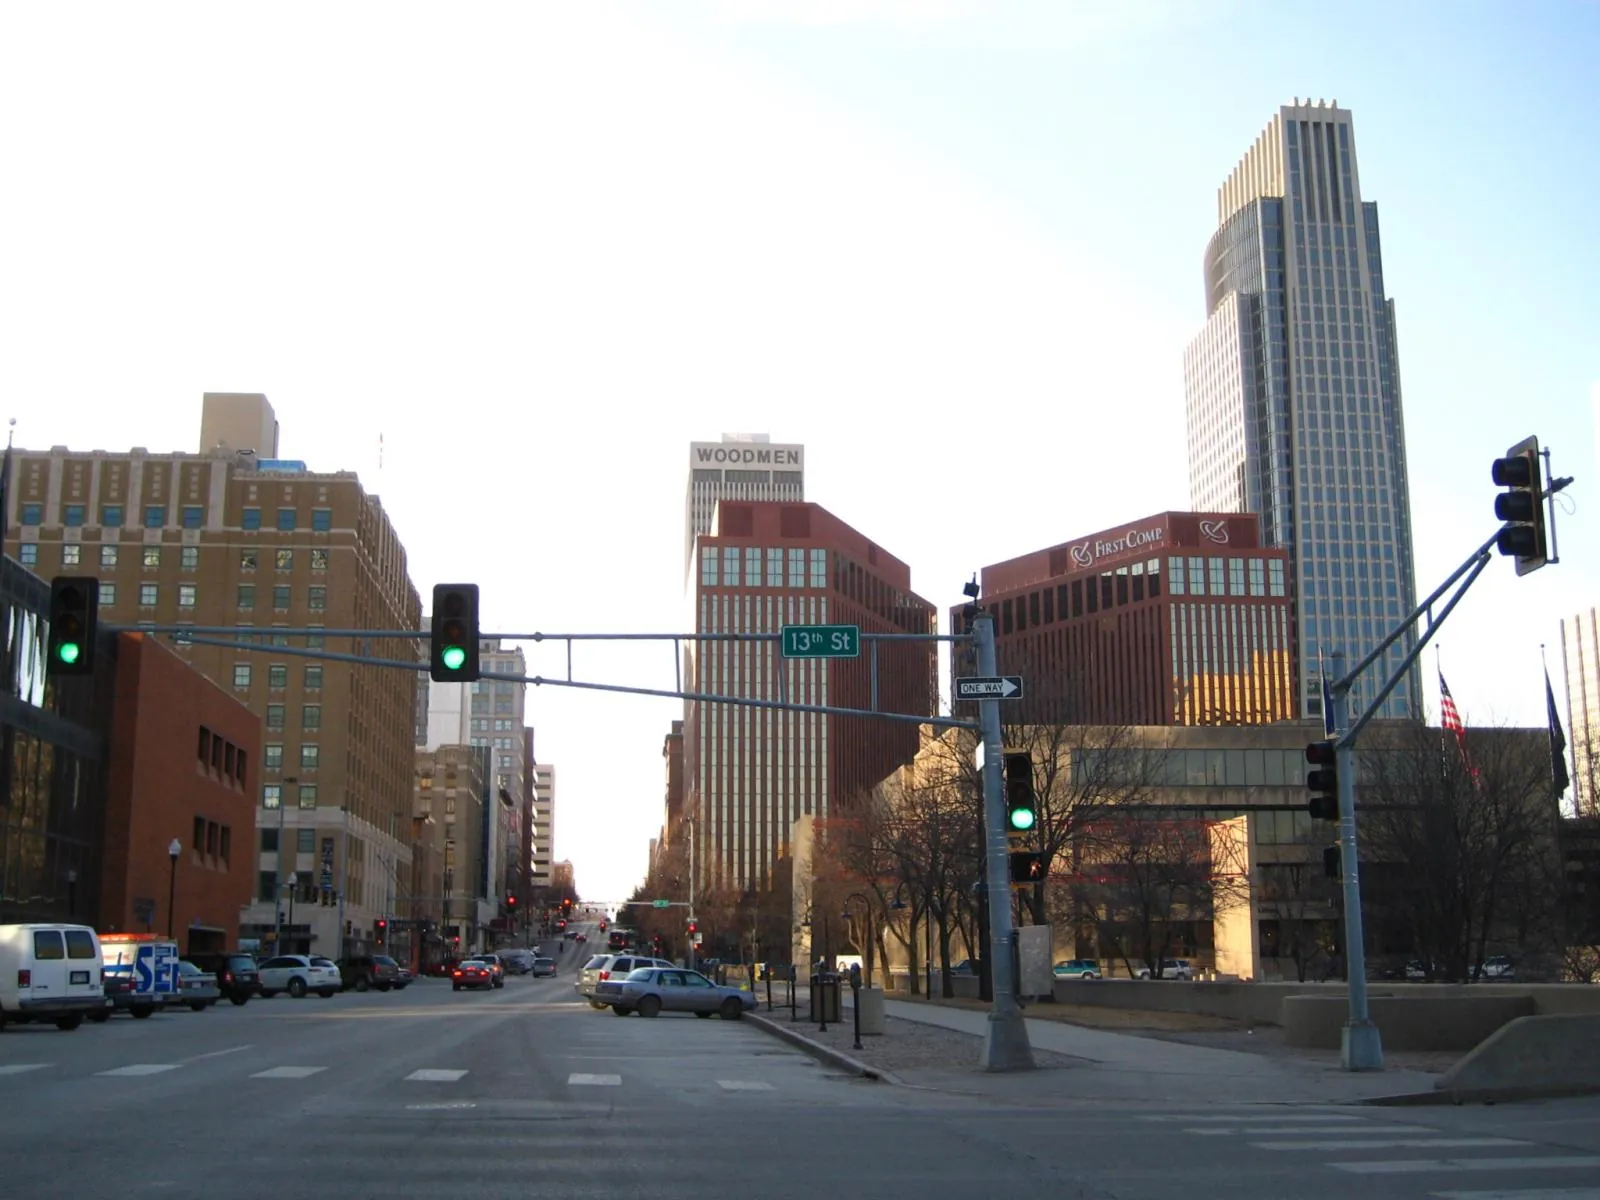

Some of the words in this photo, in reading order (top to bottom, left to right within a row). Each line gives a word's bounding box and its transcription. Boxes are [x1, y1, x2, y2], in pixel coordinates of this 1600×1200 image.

[697, 447, 799, 464] WOODMEN
[792, 632, 823, 651] 13th
[831, 632, 851, 650] St
[962, 684, 981, 693] ONE
[984, 683, 1004, 693] WAY
